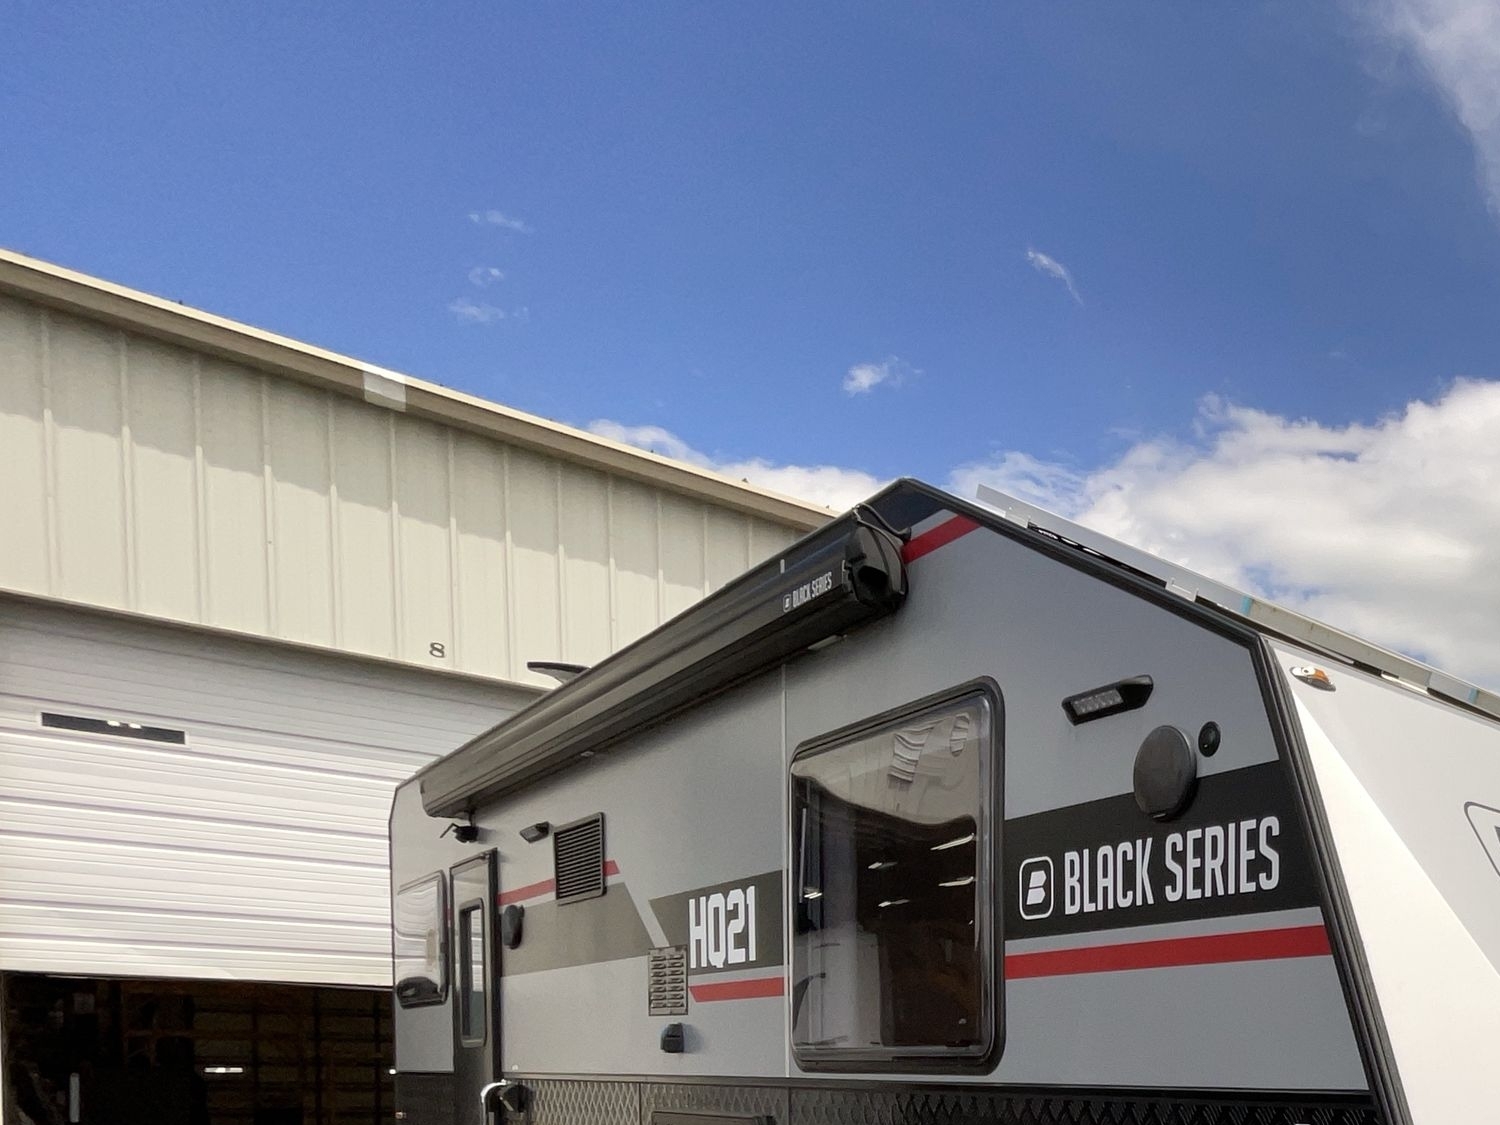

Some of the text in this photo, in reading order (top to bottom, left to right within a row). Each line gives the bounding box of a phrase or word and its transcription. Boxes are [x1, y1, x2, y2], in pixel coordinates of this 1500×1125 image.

[429, 642, 446, 658] 8
[1064, 837, 1155, 915] BLACK
[1165, 815, 1280, 902] SERIES
[688, 885, 757, 969] HQ21
